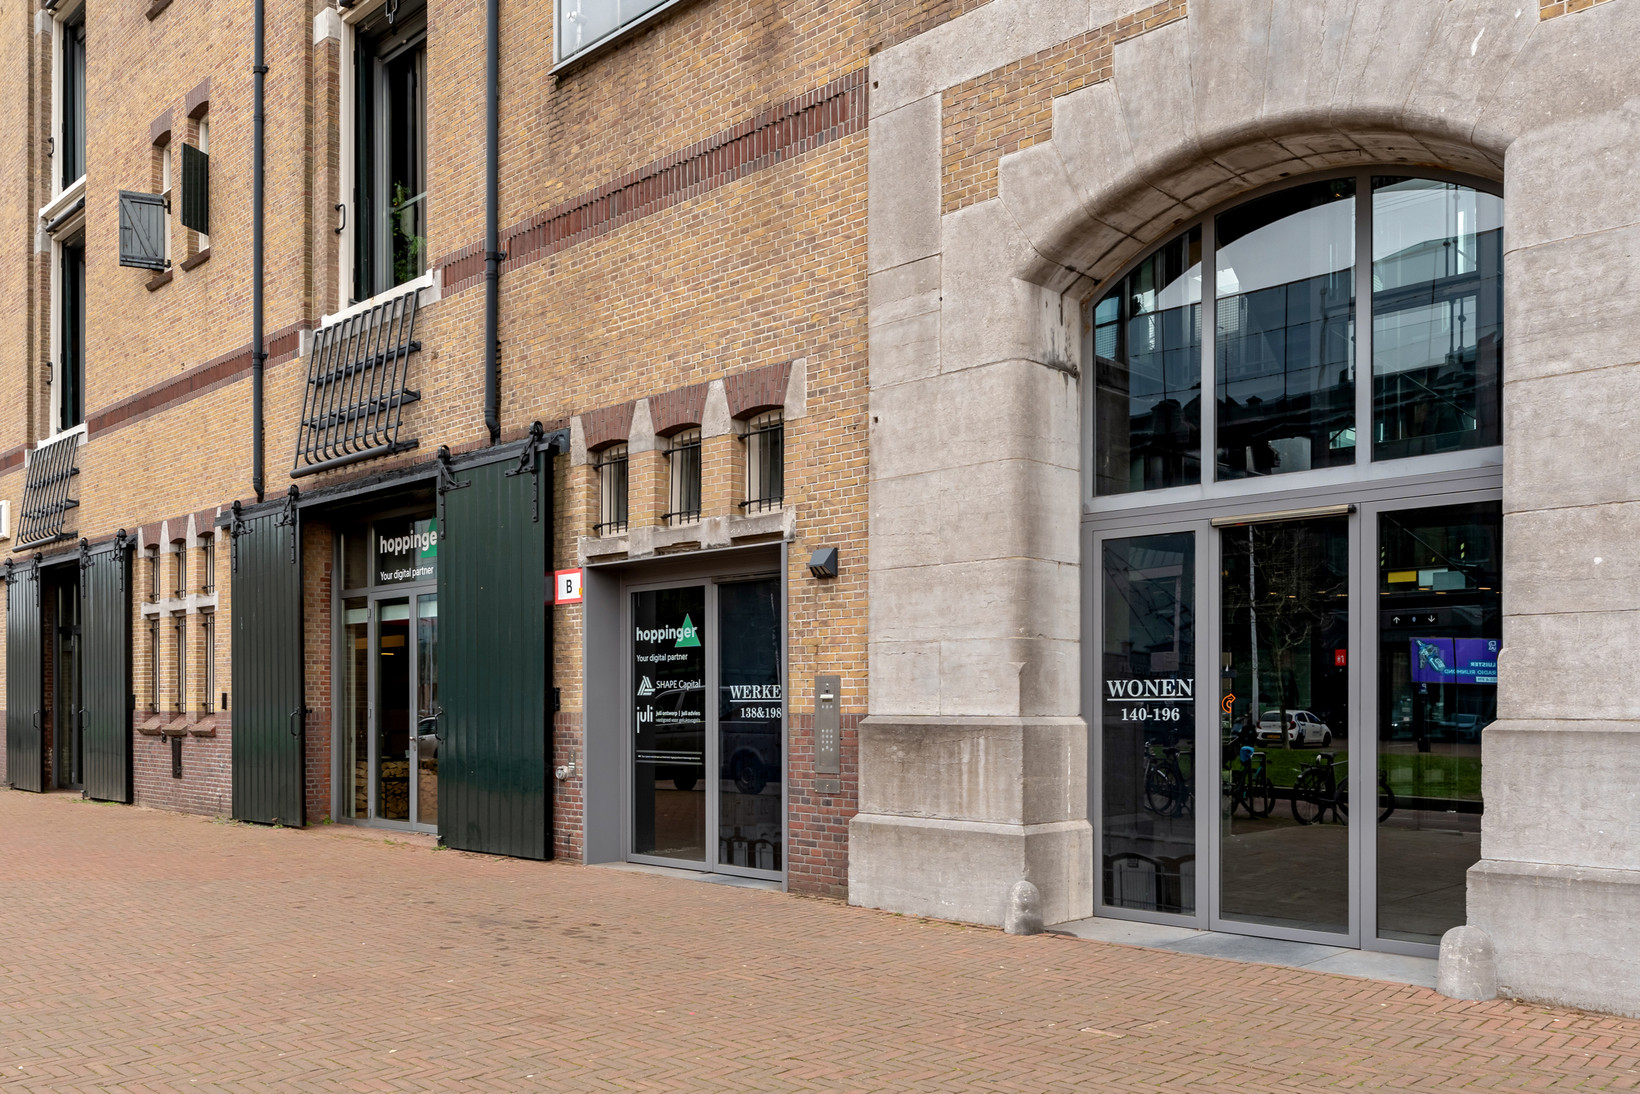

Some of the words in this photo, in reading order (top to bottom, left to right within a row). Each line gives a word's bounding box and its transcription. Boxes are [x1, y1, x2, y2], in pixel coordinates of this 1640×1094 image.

[380, 529, 437, 555] hoppinge
[380, 571, 393, 580] Your
[394, 568, 412, 580] digital
[412, 566, 434, 578] partner
[566, 579, 573, 594] B
[636, 624, 698, 643] hoppinger
[636, 654, 649, 662] Your
[649, 653, 667, 663] digital
[667, 653, 688, 662] partner
[656, 680, 678, 689] SHAPE
[678, 679, 701, 691] Capital
[730, 684, 782, 699] WERKE
[1106, 679, 1194, 697] WONEN
[636, 704, 653, 734] juli
[740, 706, 782, 719] 138&198
[1121, 707, 1181, 721] 140-196
